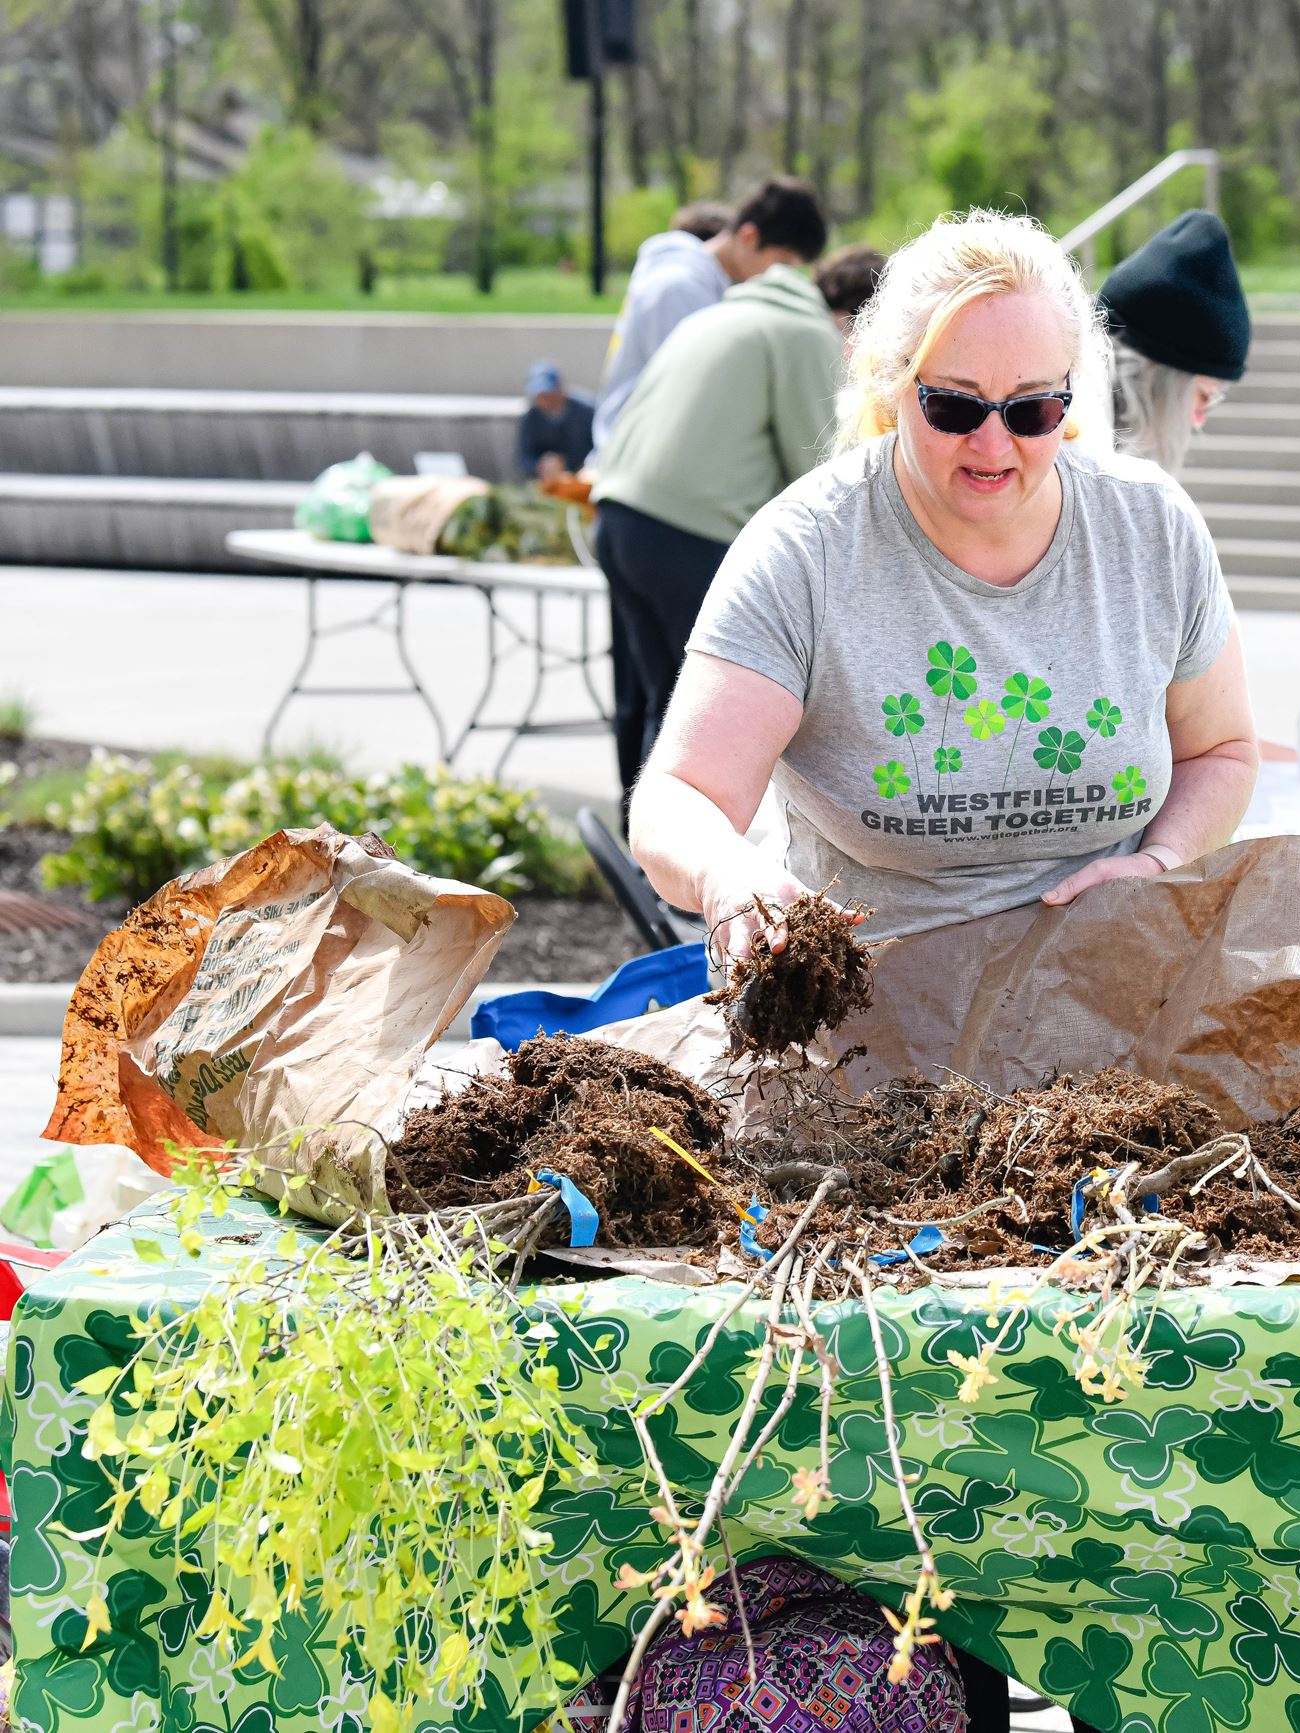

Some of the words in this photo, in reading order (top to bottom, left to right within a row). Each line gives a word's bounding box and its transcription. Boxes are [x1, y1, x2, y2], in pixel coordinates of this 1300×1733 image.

[917, 784, 1107, 813] WESTFIELD
[861, 810, 973, 836] GREEN
[985, 797, 1152, 830] TOGETHER
[943, 825, 1078, 844] www.wgtogether.org
